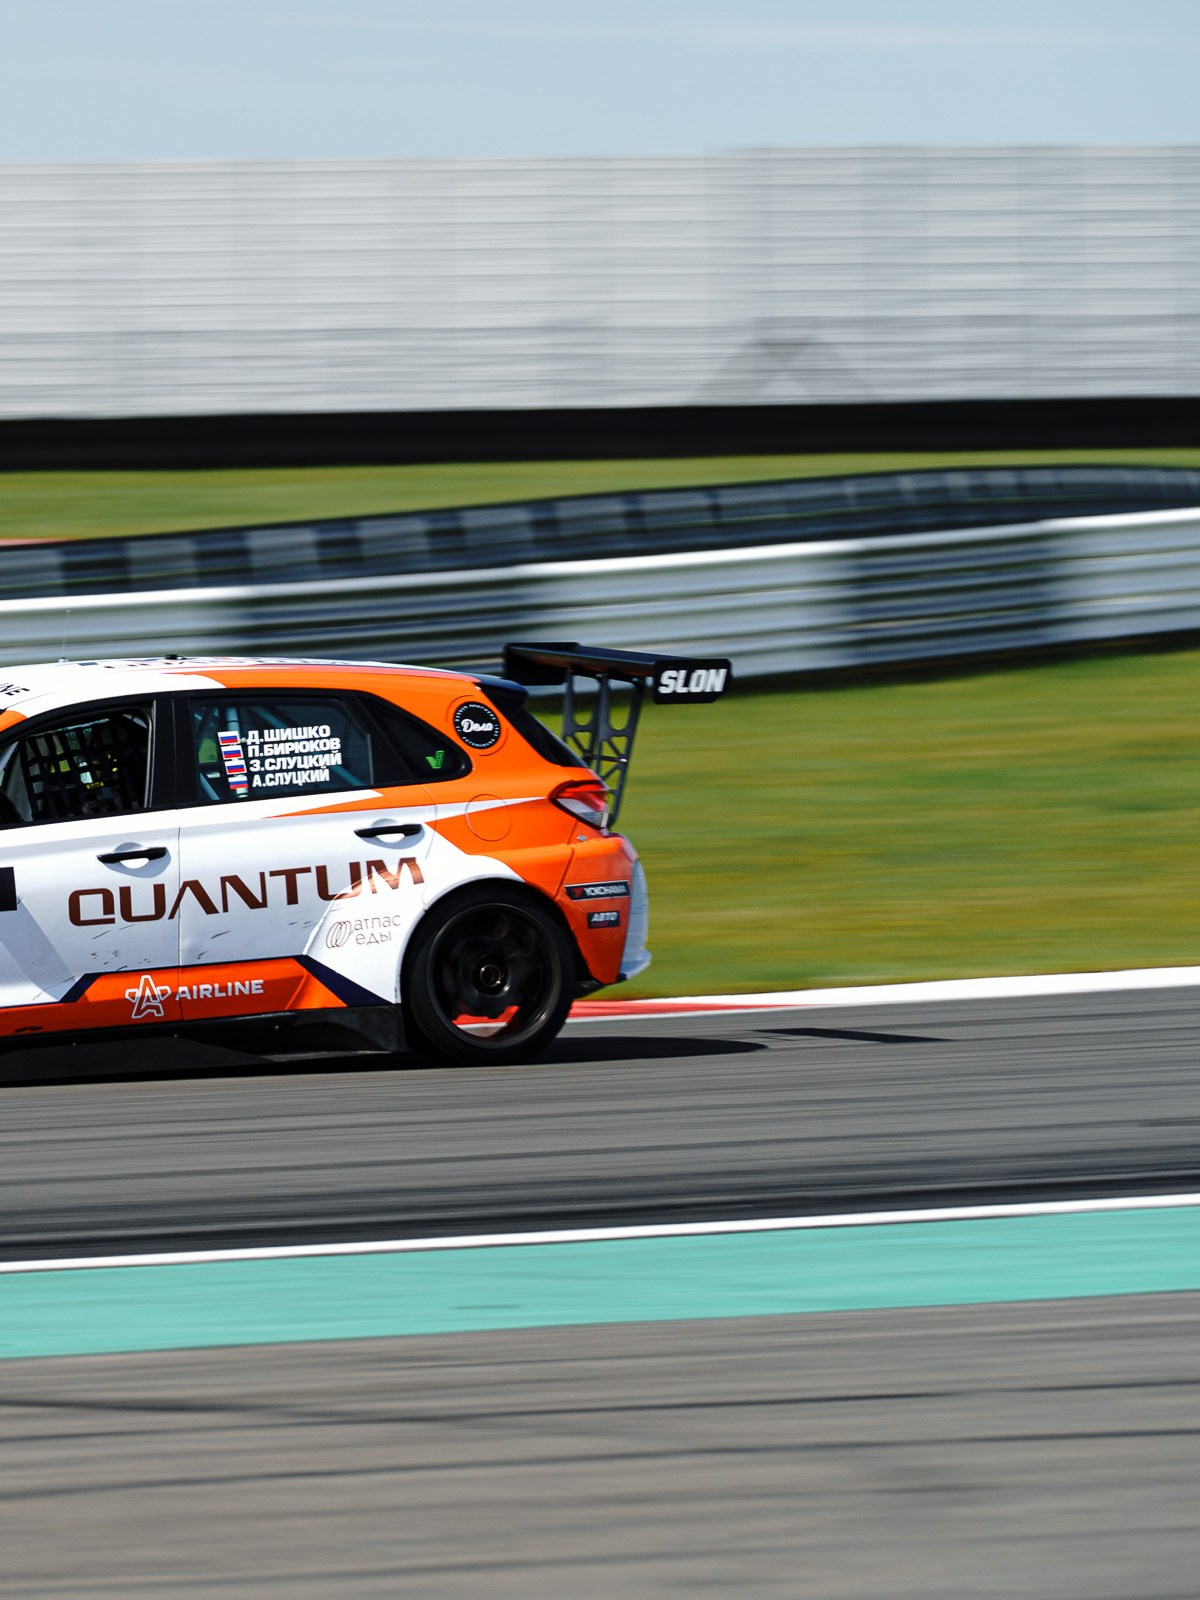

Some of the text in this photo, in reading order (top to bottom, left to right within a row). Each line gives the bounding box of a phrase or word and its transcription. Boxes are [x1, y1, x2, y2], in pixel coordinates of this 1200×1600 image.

[658, 668, 728, 694] SLON
[246, 725, 331, 745] Д.ШИШКО
[247, 737, 341, 758] П.БИРЮКОВ
[252, 767, 330, 787] А.СЛУЦКИЙ
[68, 857, 424, 926] QUANTUM
[175, 979, 264, 1001] AIRLINE
